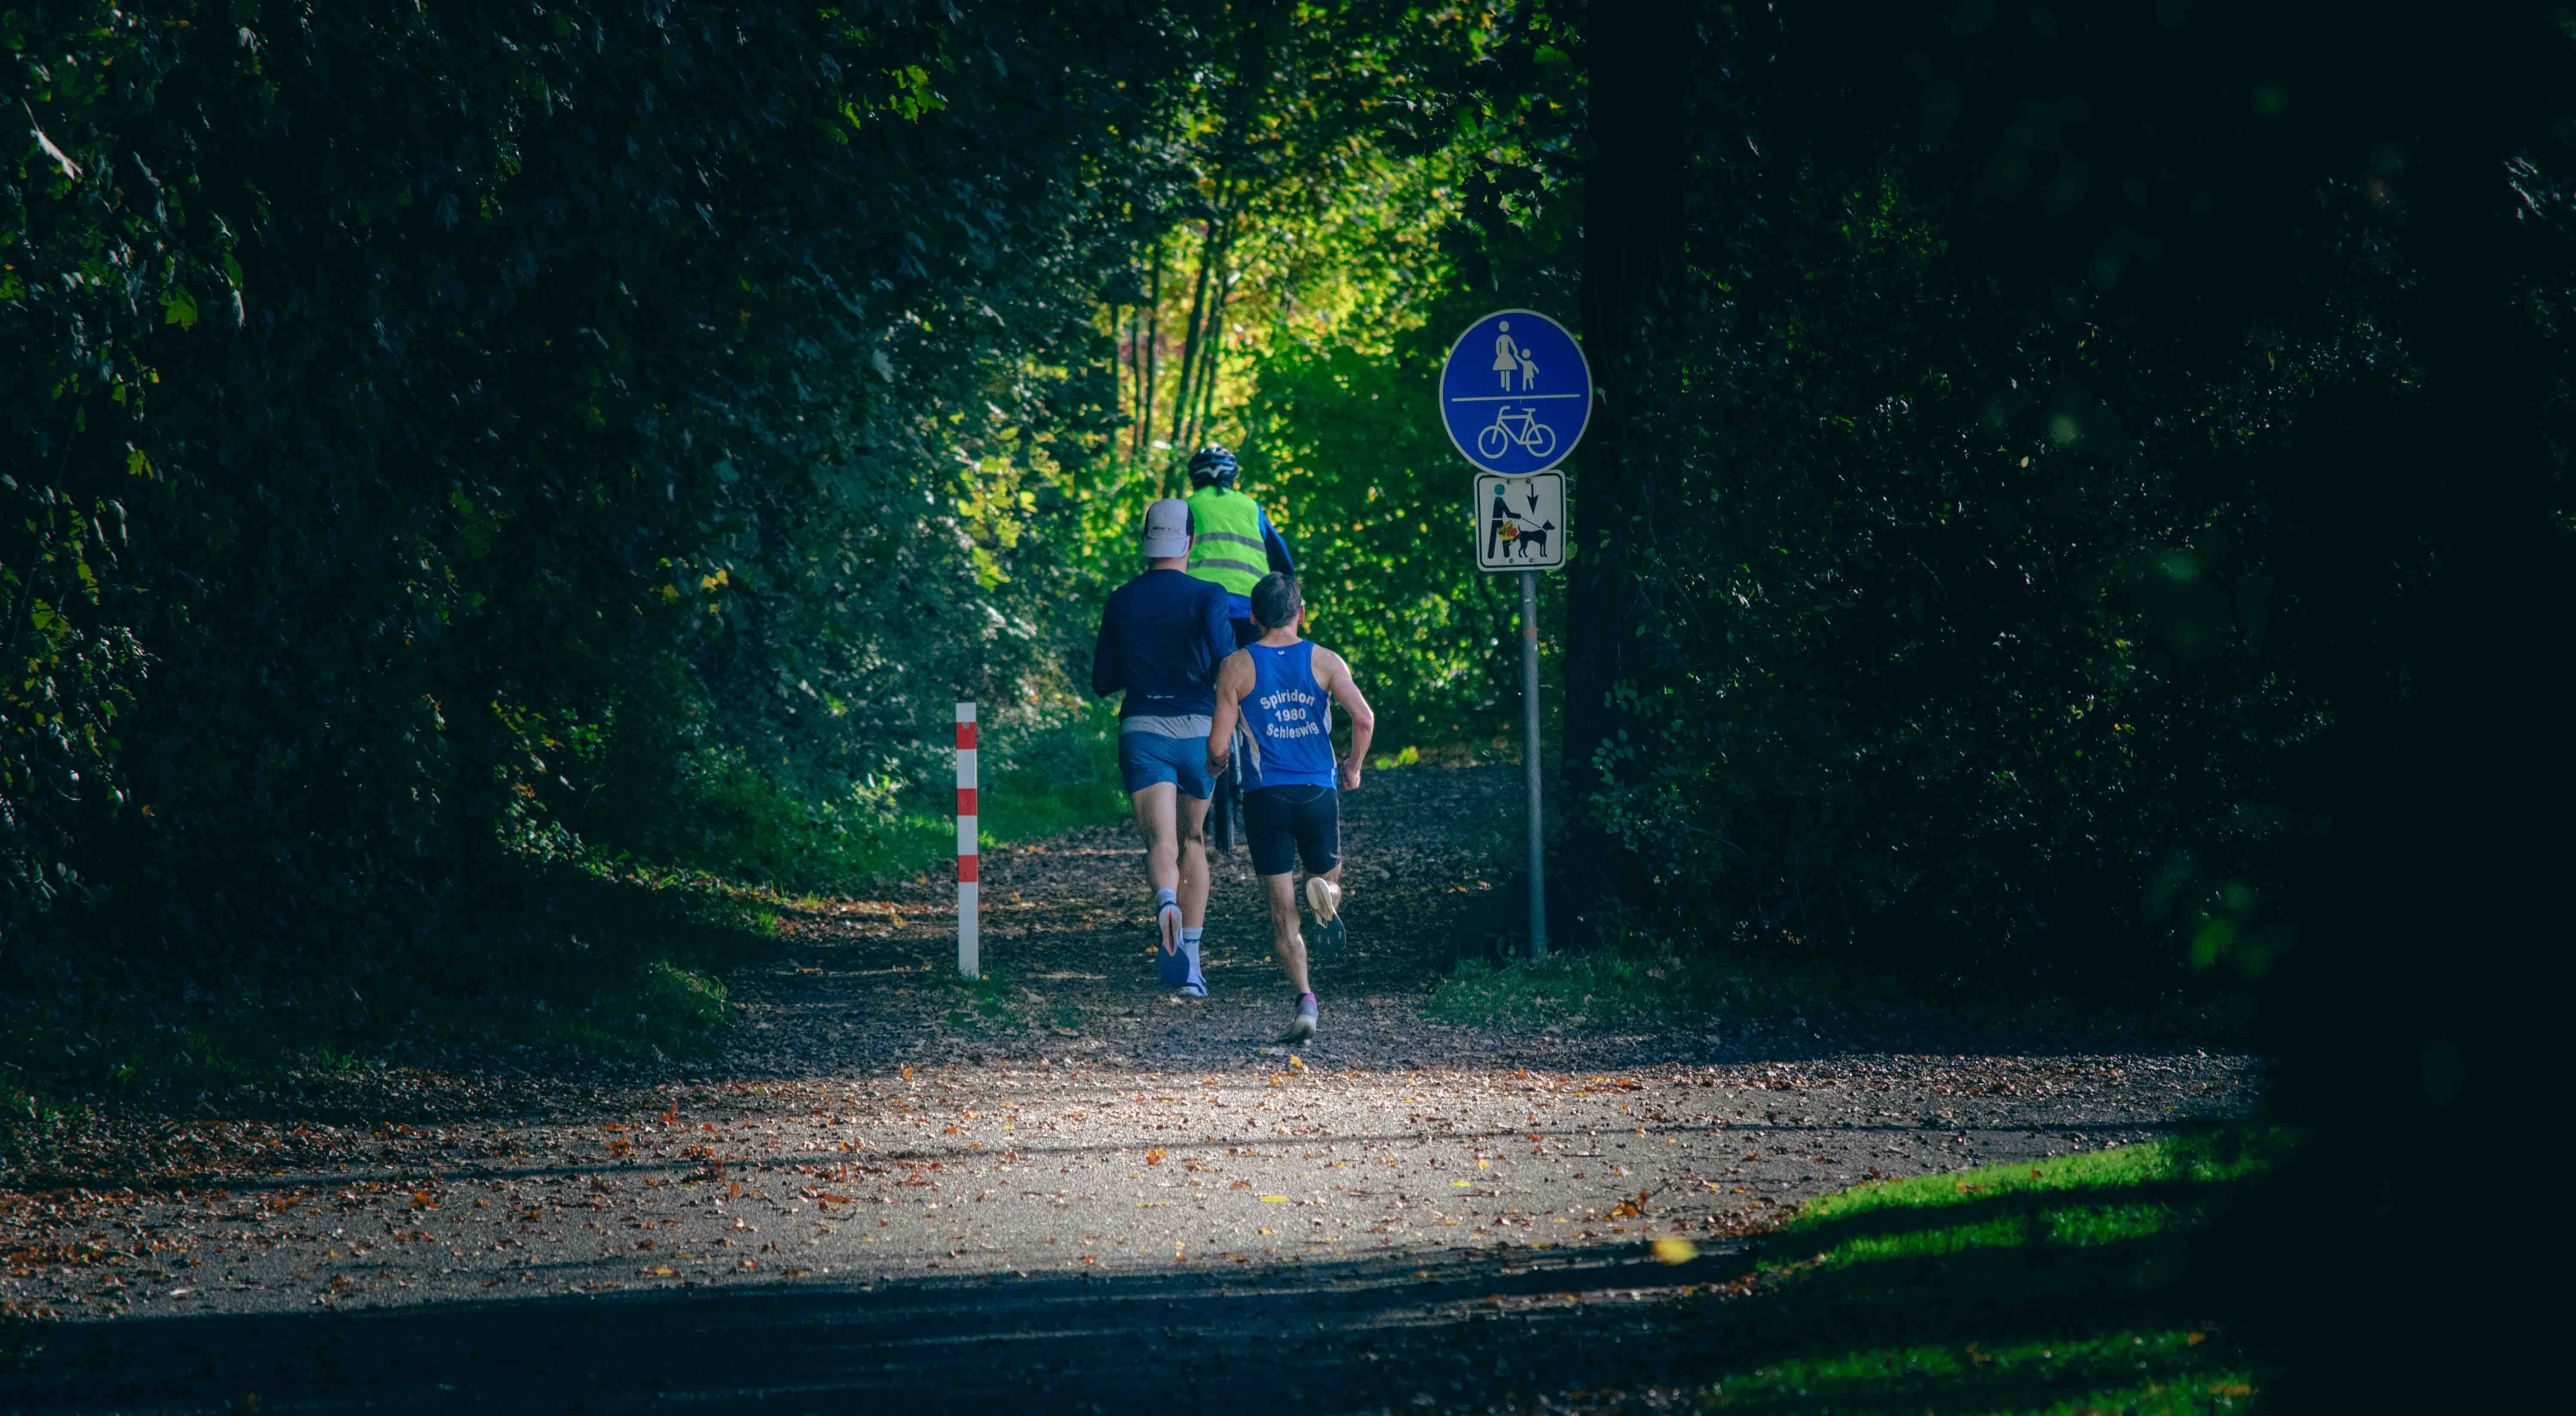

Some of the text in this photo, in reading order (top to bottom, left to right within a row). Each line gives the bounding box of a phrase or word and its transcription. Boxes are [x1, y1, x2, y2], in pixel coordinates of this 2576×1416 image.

[1260, 689, 1315, 709] Spiridon
[1275, 708, 1306, 722] 1980
[1267, 722, 1319, 738] Schleswig
